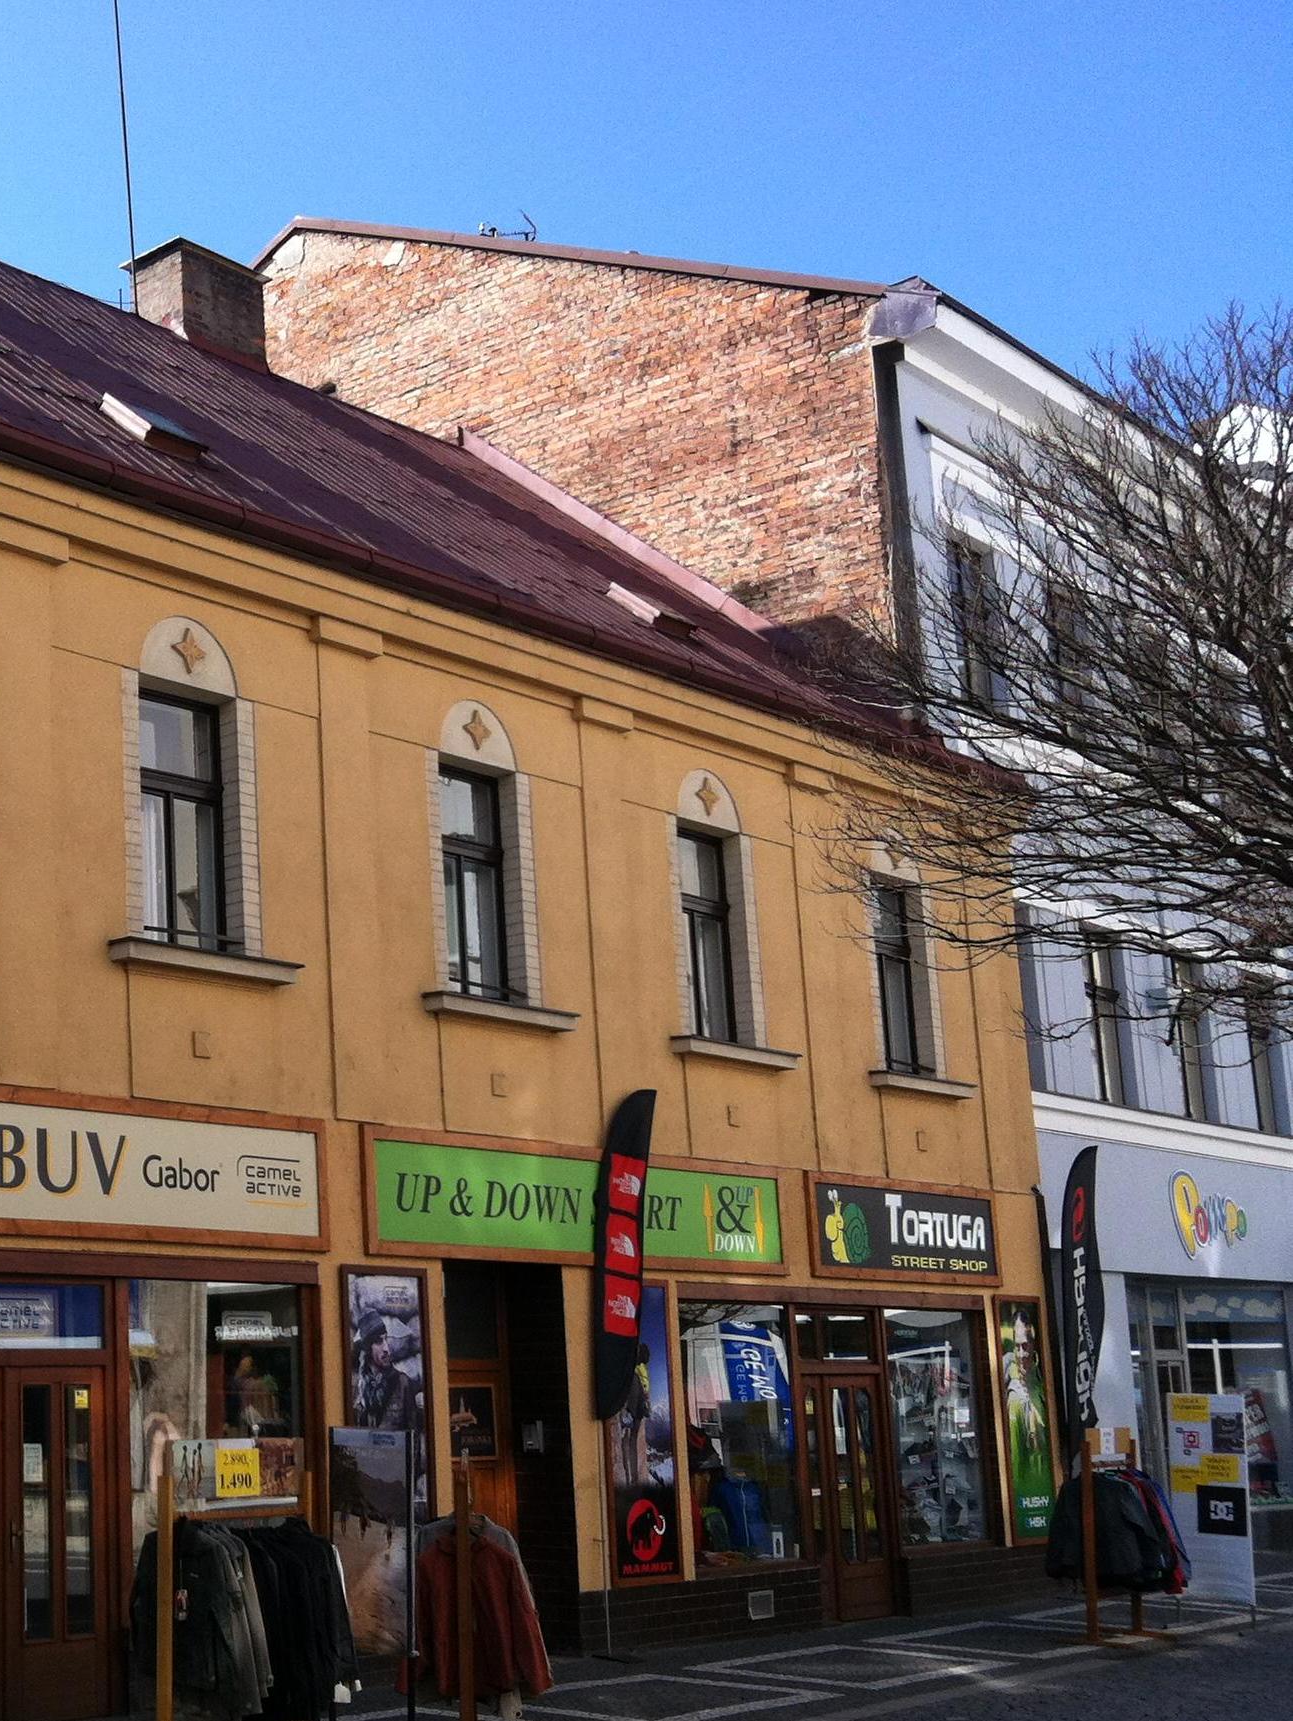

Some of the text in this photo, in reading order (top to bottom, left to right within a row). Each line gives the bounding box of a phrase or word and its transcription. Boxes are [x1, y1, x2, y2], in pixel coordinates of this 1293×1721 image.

[142, 1154, 220, 1192] Gabor
[396, 1172, 441, 1213] UP
[449, 1177, 473, 1217] &
[483, 1180, 582, 1224] DOWN
[735, 1185, 754, 1204] UP
[884, 1193, 987, 1251] TORTUGA
[714, 1233, 756, 1253] DOWN
[891, 1254, 988, 1272] STREET SHOP
[623, 1562, 674, 1575] MAMMUT
